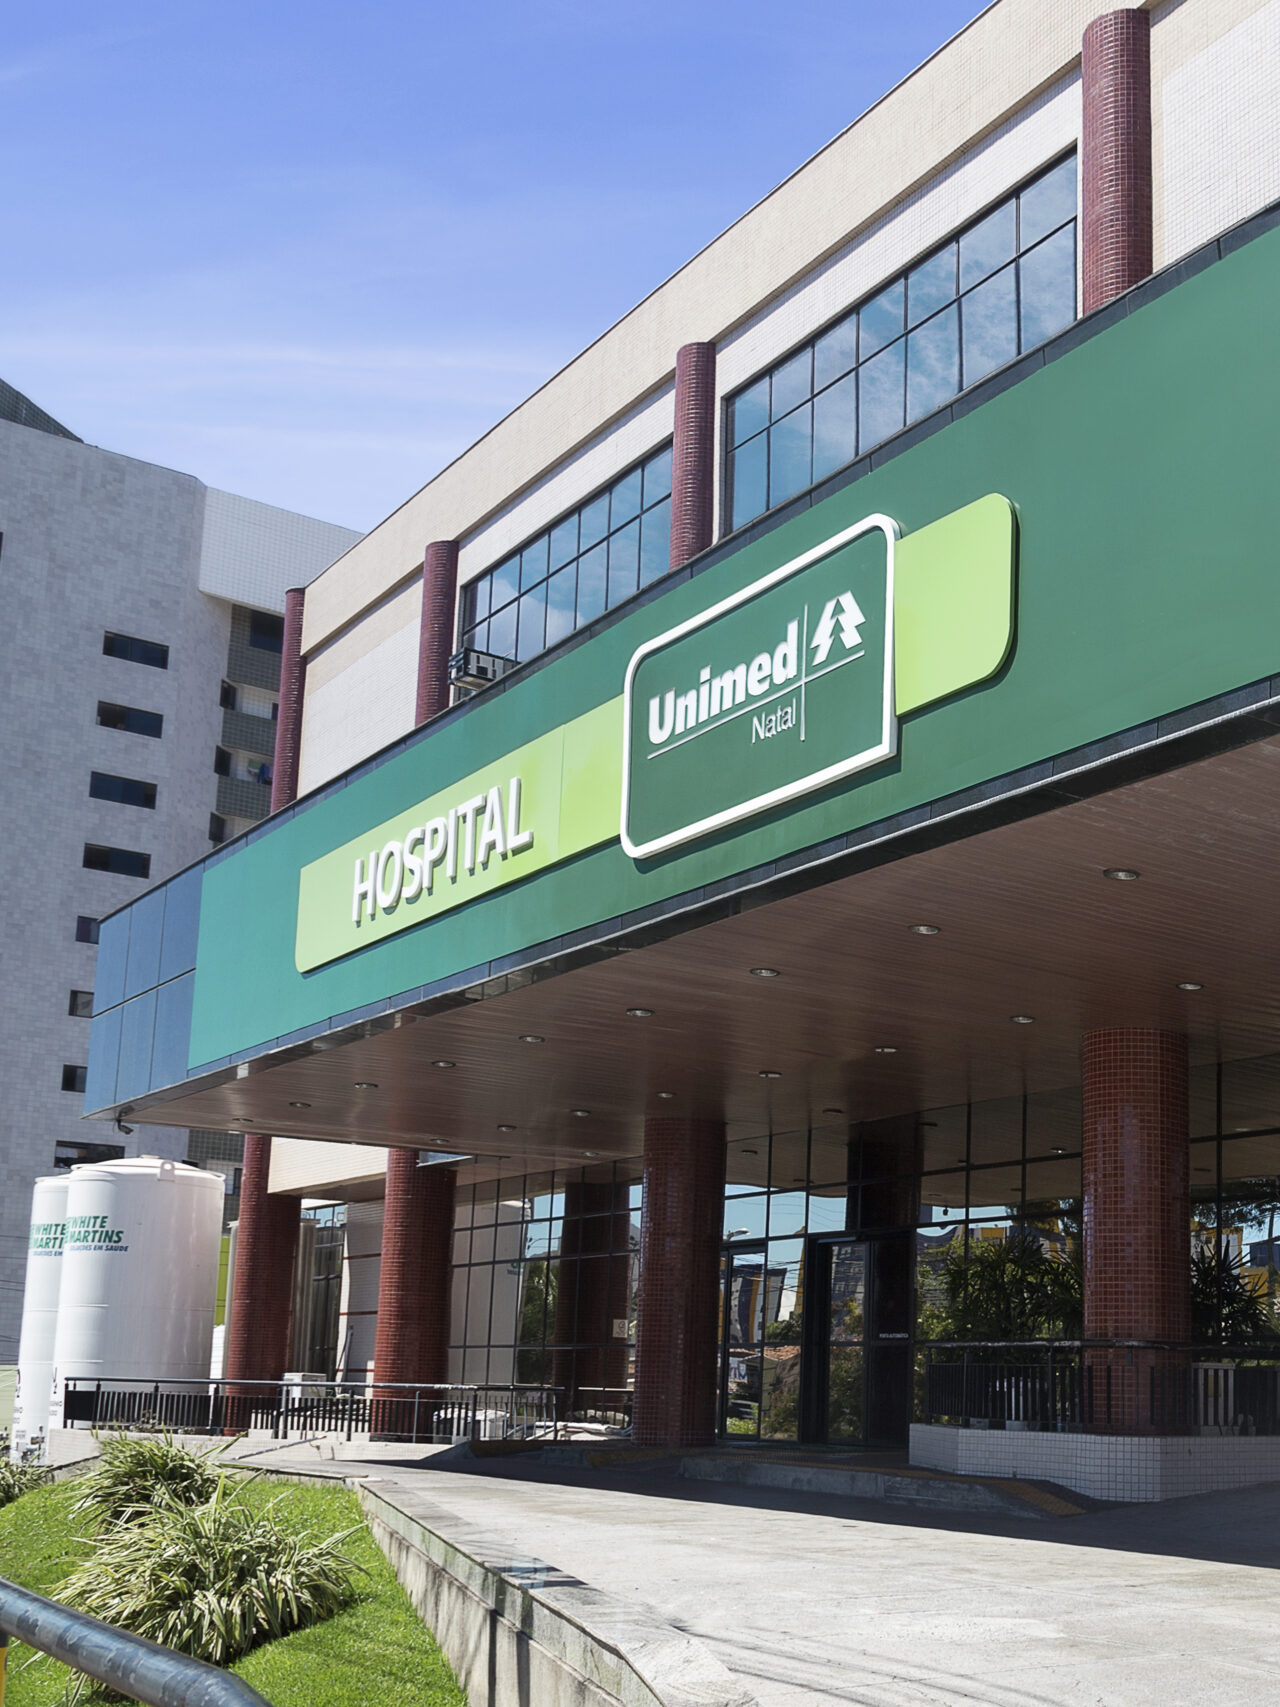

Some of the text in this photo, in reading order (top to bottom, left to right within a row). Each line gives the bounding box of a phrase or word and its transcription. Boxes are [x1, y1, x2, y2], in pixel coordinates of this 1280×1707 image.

[648, 617, 800, 745] Unimed
[751, 697, 797, 744] Natal
[351, 776, 534, 923] HOSPITAL
[69, 1230, 124, 1244] MARTINS
[71, 1216, 108, 1229] WHITE
[33, 1237, 64, 1249] MARTI
